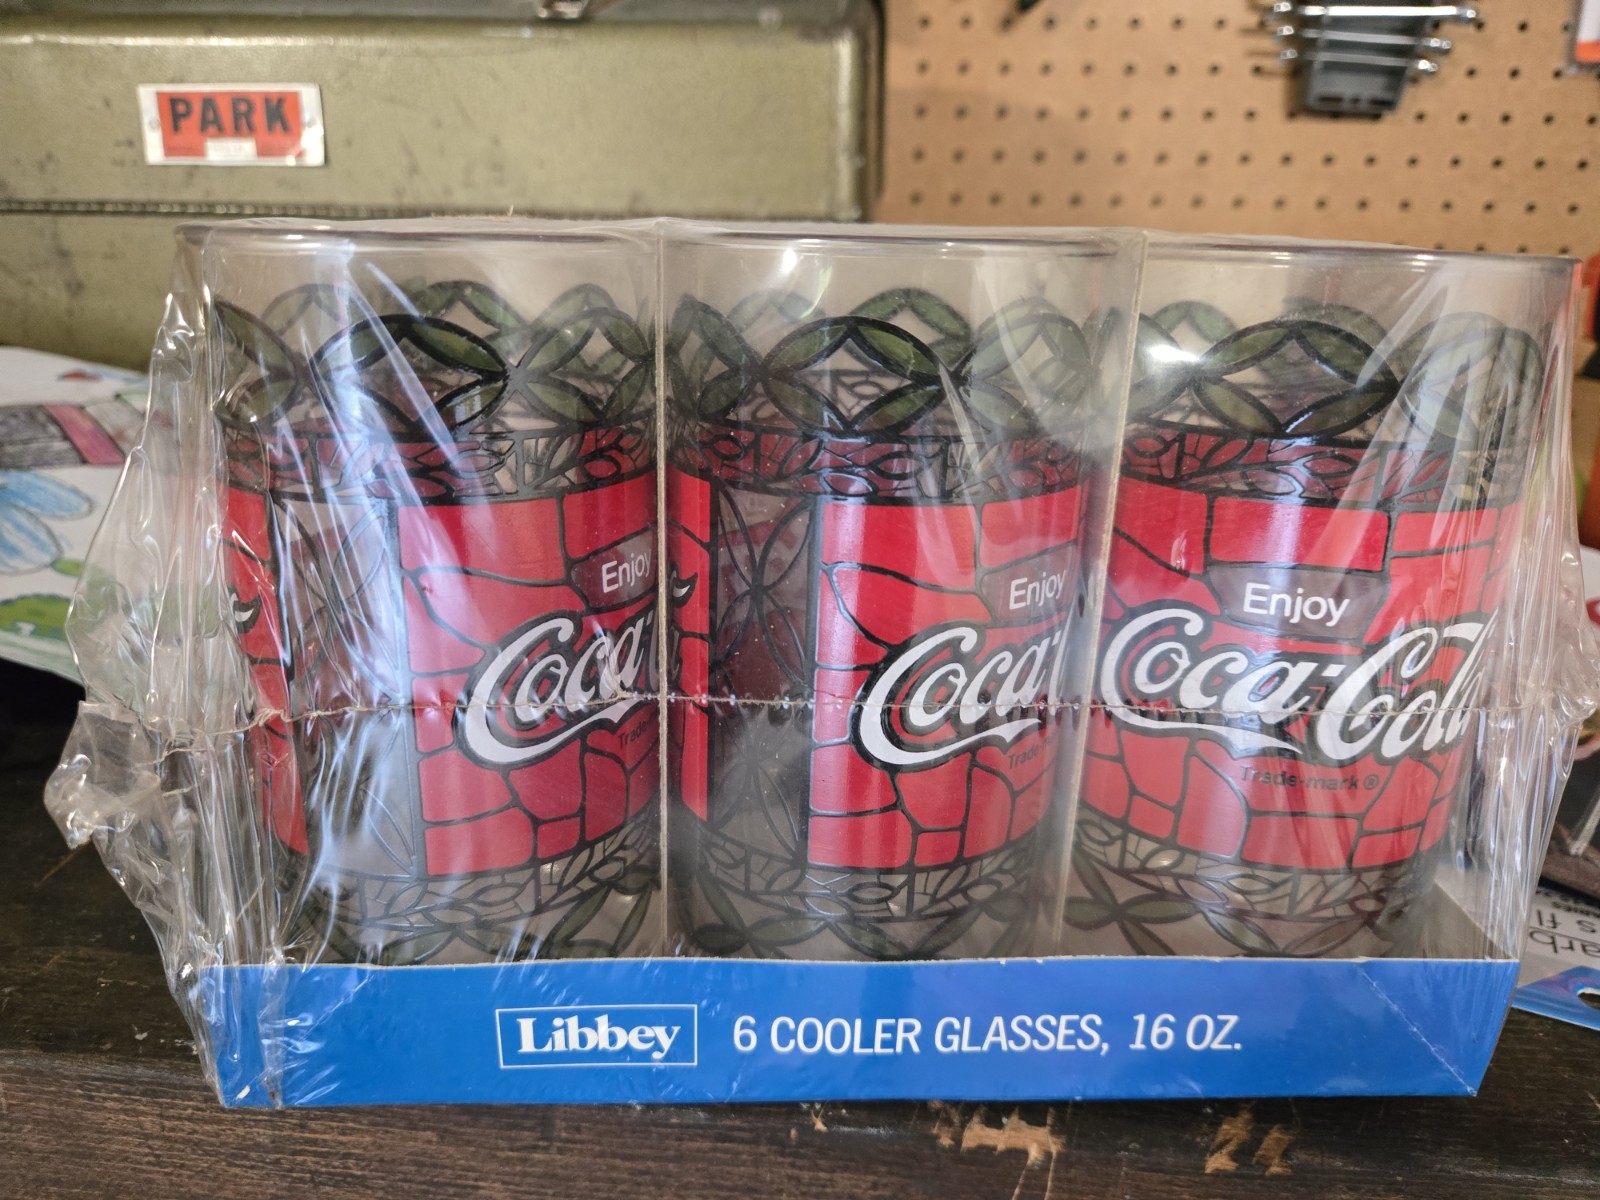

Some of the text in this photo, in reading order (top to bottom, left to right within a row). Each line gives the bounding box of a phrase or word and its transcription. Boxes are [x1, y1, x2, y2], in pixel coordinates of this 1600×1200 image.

[168, 96, 291, 134] PARK
[602, 551, 650, 593] Enjoy
[1009, 570, 1066, 610] Enjoy
[1242, 581, 1351, 627] Enjoy
[860, 612, 1070, 765] Coca-
[1240, 764, 1359, 791] Trade-mark
[516, 1014, 681, 1059] Libbey
[733, 1013, 1241, 1056] 6 COOLER GLASSES, 16 OZ.
